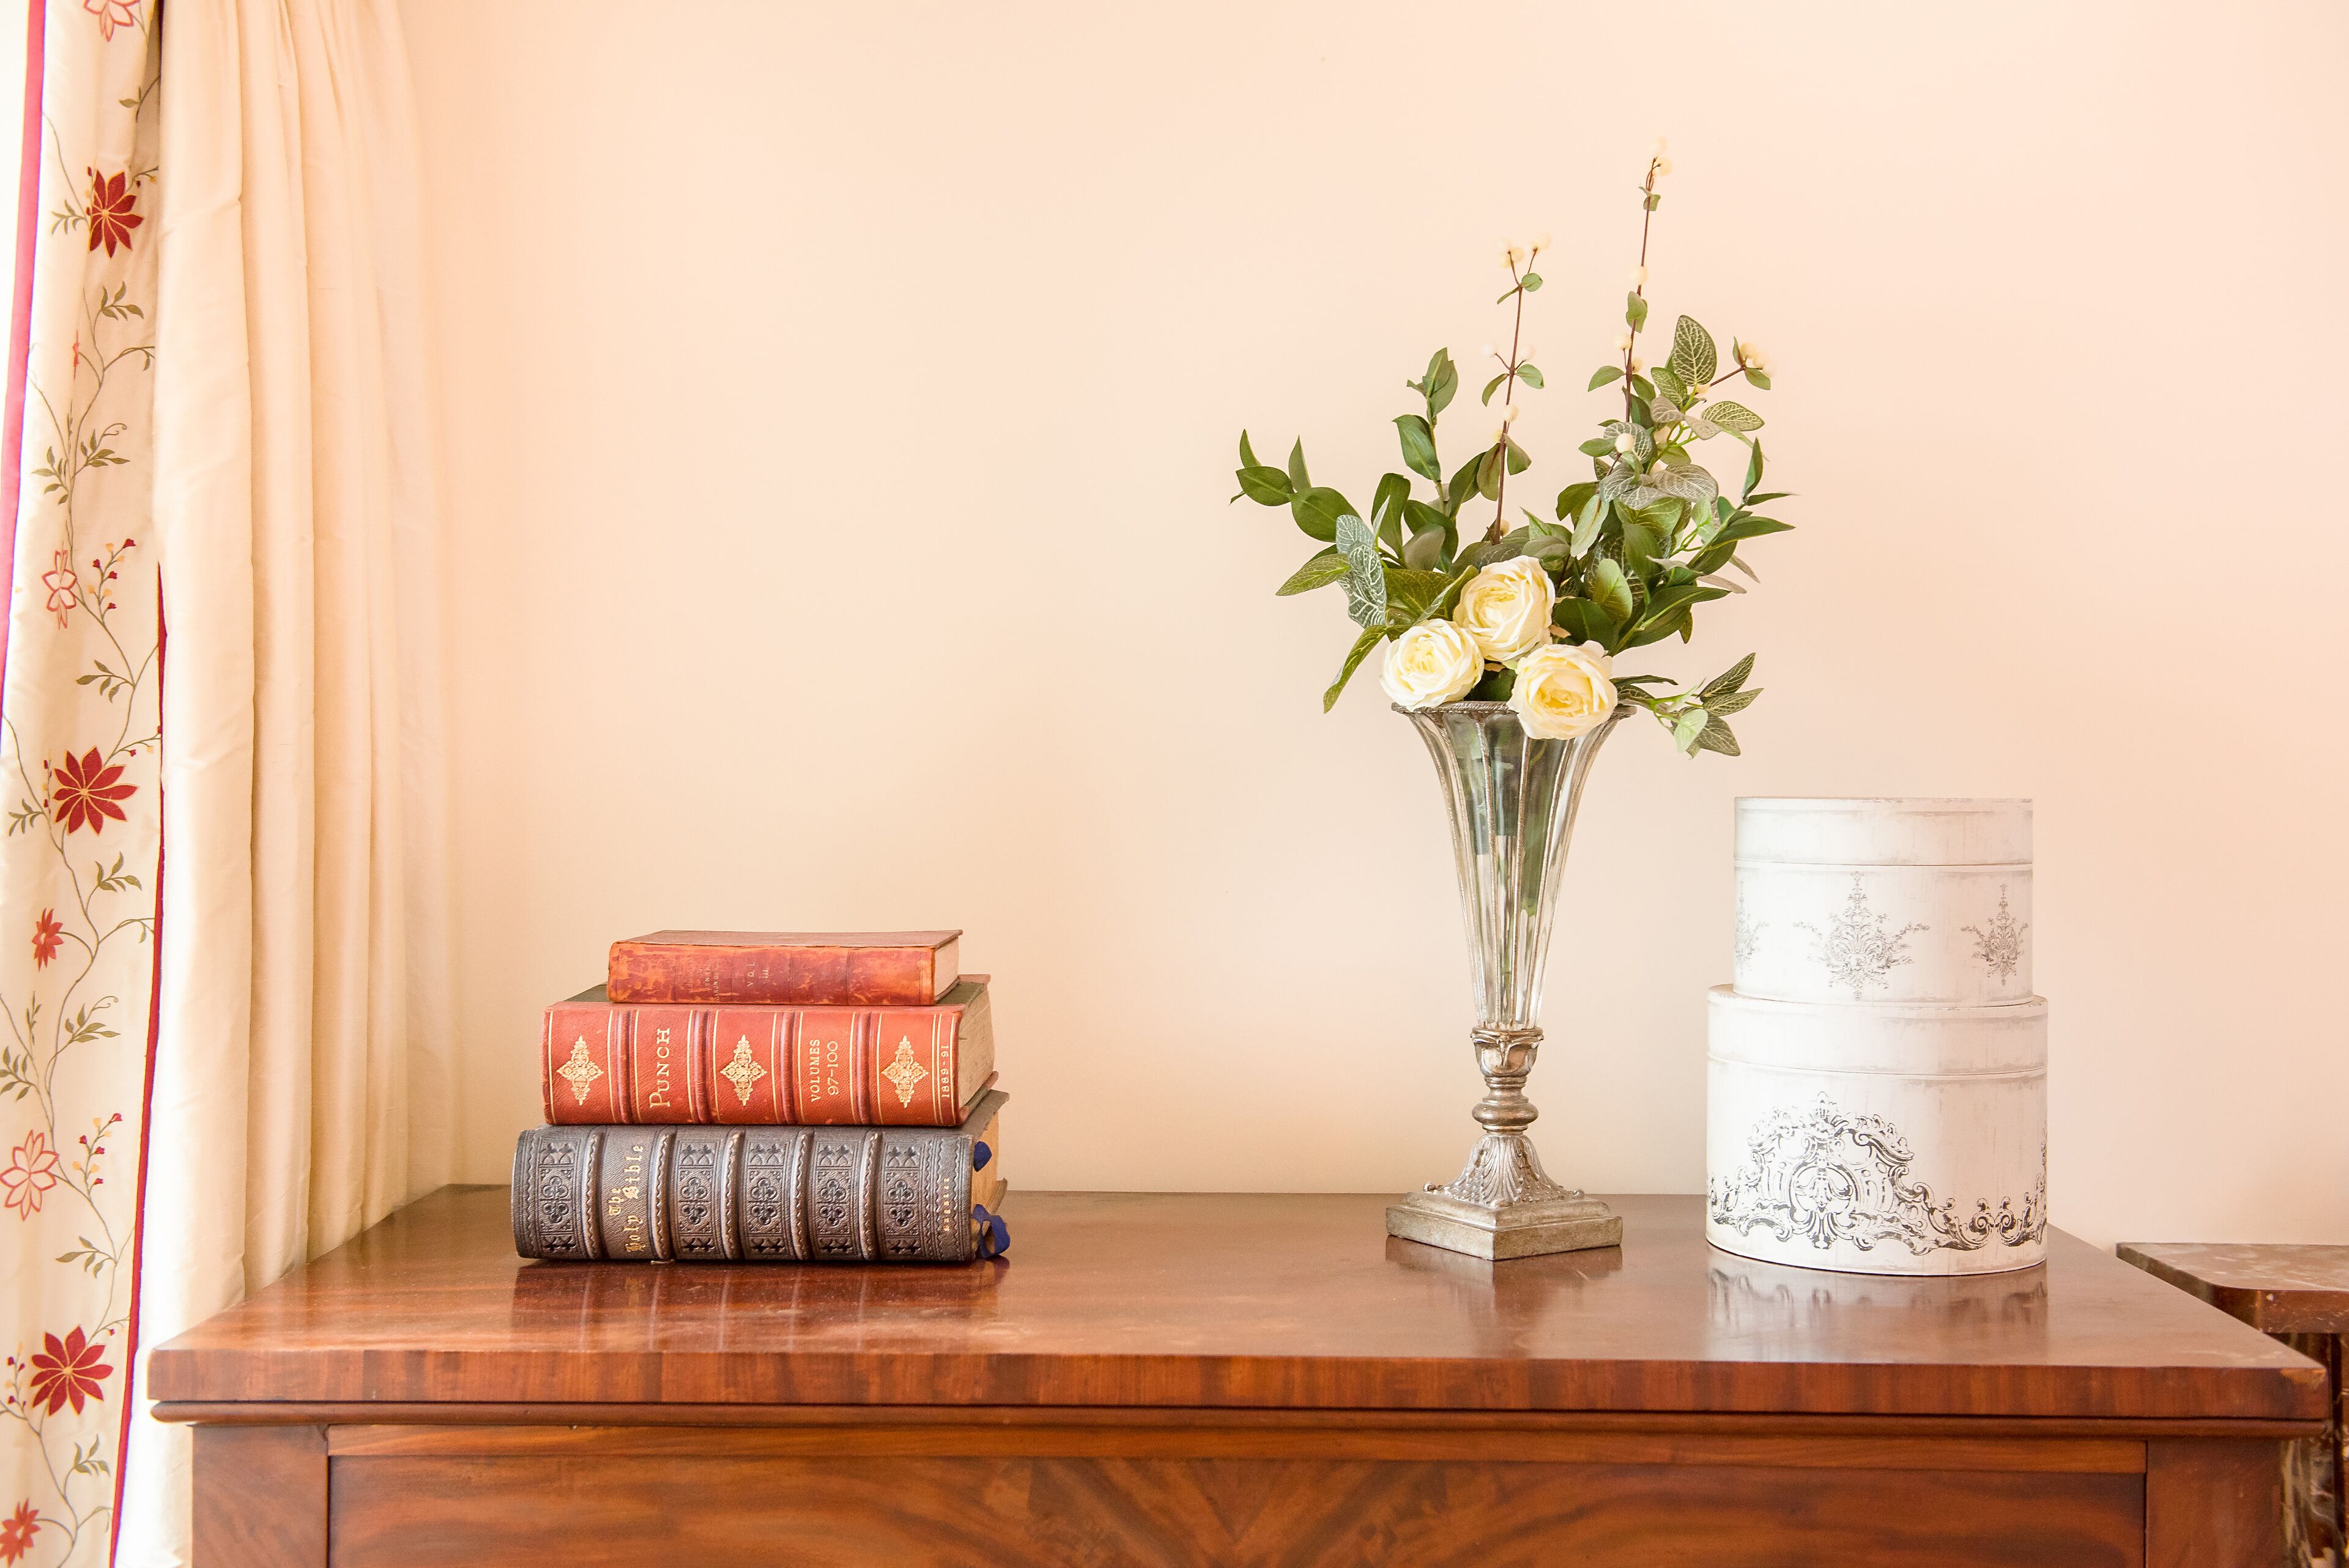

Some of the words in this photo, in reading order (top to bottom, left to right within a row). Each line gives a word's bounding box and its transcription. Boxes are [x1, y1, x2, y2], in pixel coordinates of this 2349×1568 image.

[648, 1027, 670, 1107] PUNCH
[809, 1038, 821, 1101] VOLUMES
[826, 1040, 839, 1095] 97-100
[622, 1144, 644, 1199] Bible
[607, 1187, 624, 1215] The
[623, 1214, 646, 1252] Holy
